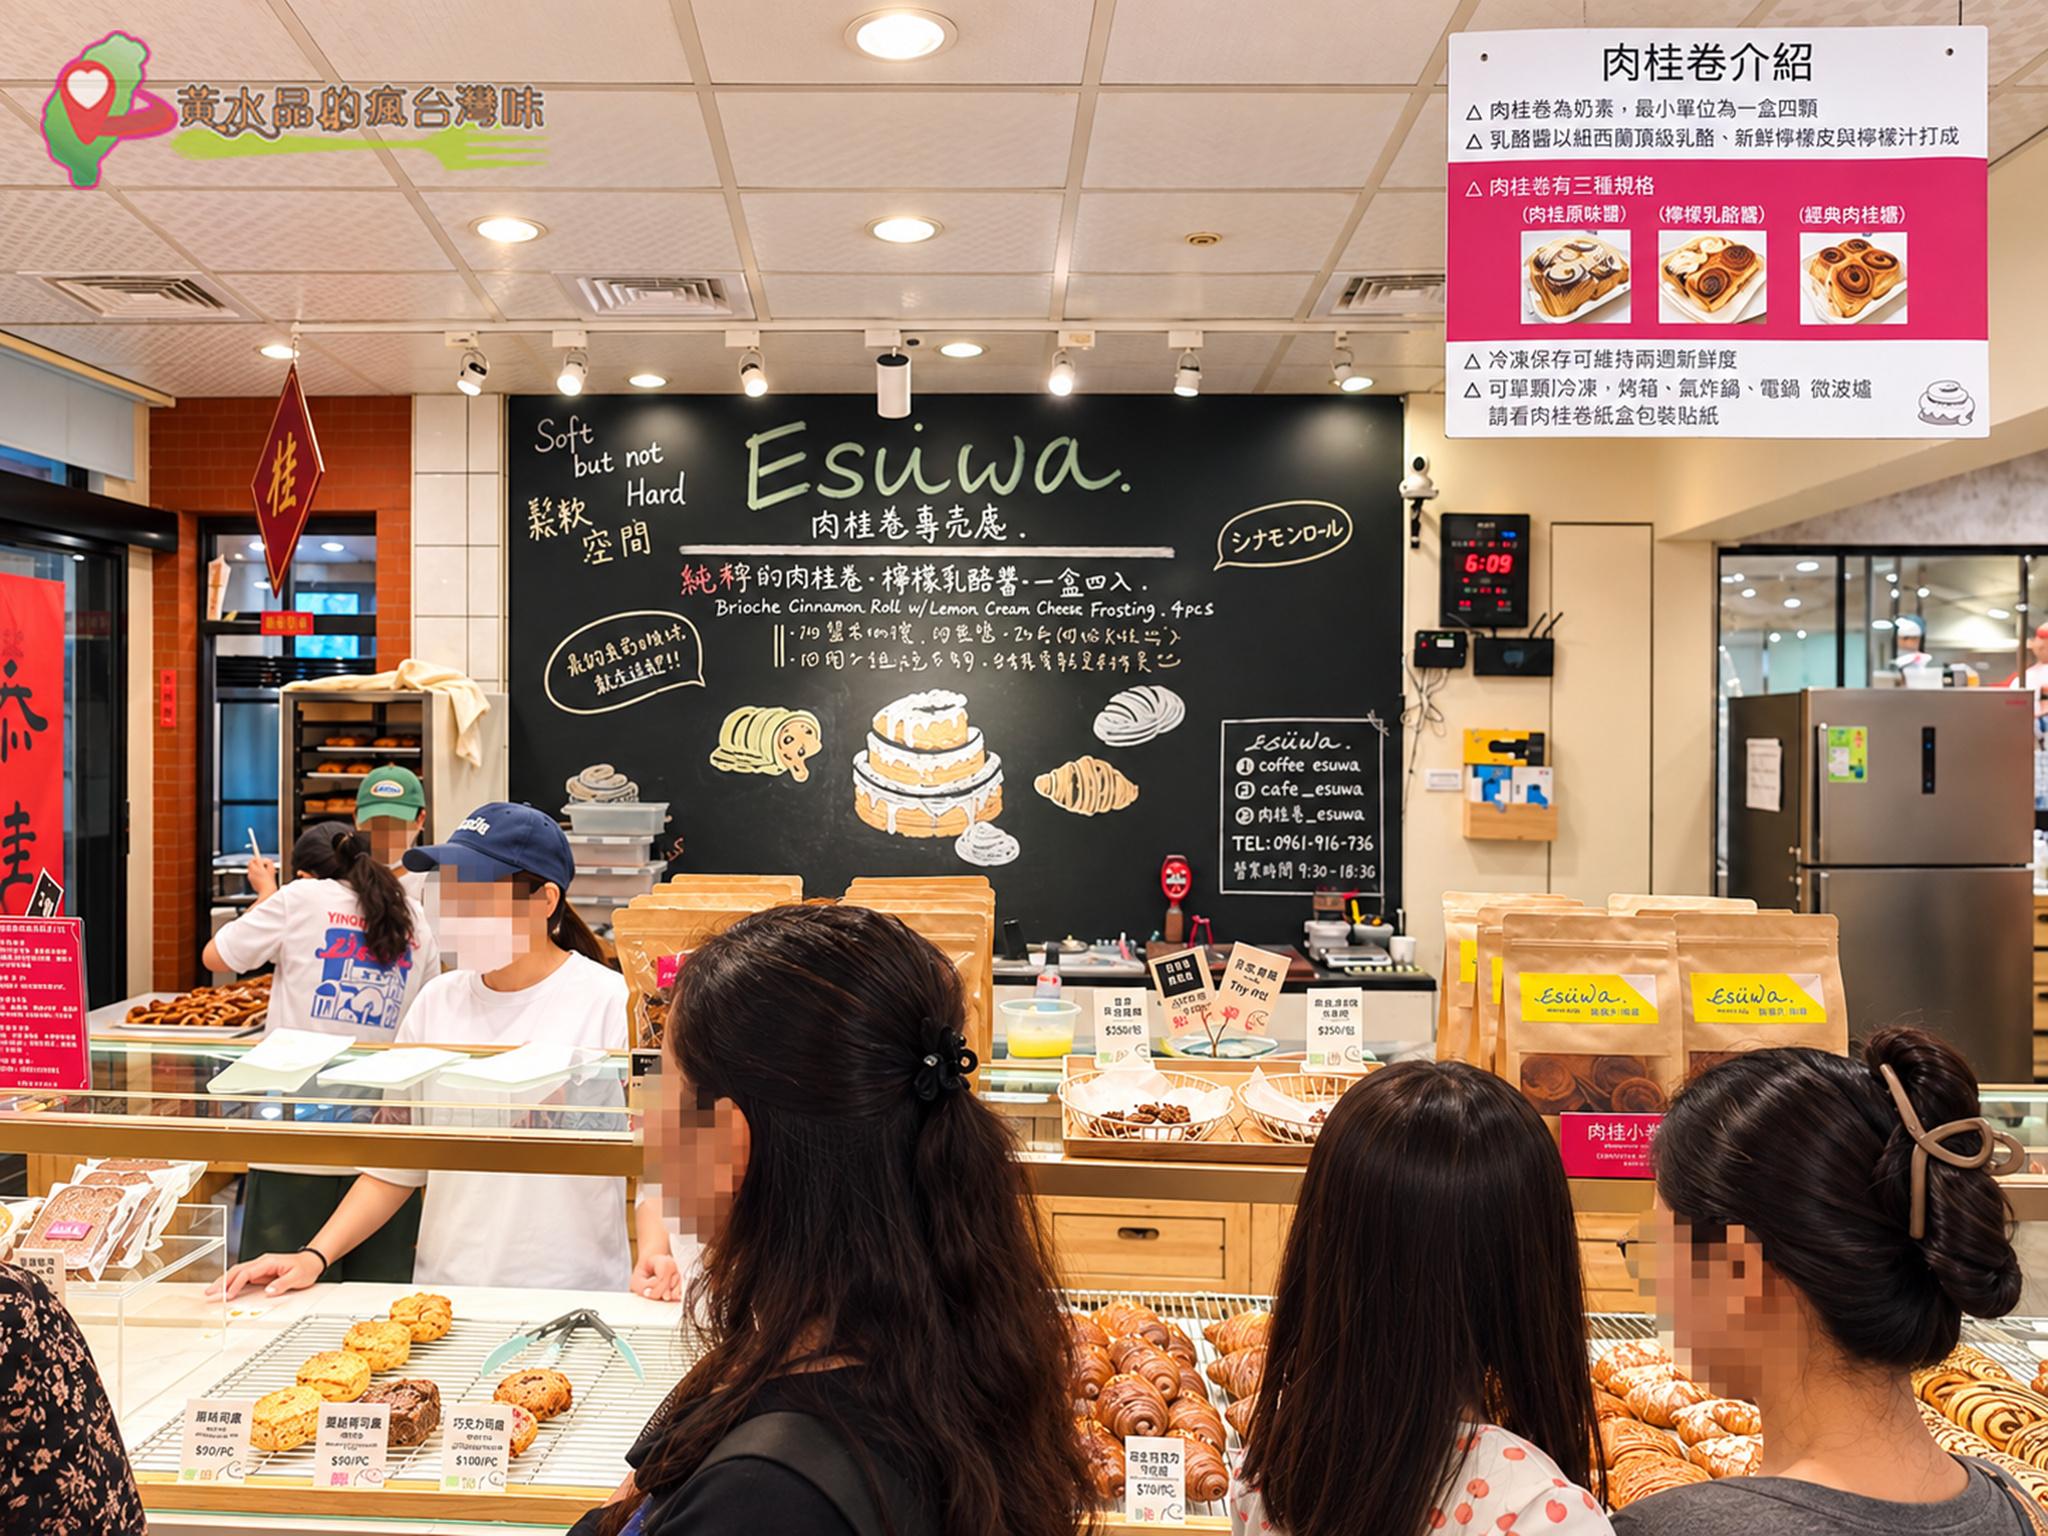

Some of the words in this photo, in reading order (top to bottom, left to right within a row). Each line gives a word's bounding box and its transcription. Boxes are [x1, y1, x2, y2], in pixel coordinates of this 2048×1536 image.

[1603, 43, 1814, 83] 肉桂卷介紹
[1489, 176, 1655, 197] 肉桂卷有三種規格
[1489, 349, 1737, 370] 冷凍保存可維持兩週新鮮度
[534, 415, 594, 454] Soft
[266, 431, 298, 518] 桂
[574, 451, 615, 478] but
[626, 442, 664, 468] not
[627, 471, 687, 507] Hard
[1231, 517, 1345, 555] シナモンロール
[1464, 553, 1514, 574] 6:09
[714, 598, 782, 617] Brioche
[788, 598, 867, 615] Cinnamon
[870, 598, 902, 615] Roll
[984, 600, 1031, 616] Cream
[1170, 600, 1215, 620] 4pcs
[1258, 757, 1306, 773] coffee
[1312, 760, 1362, 773] esuwa
